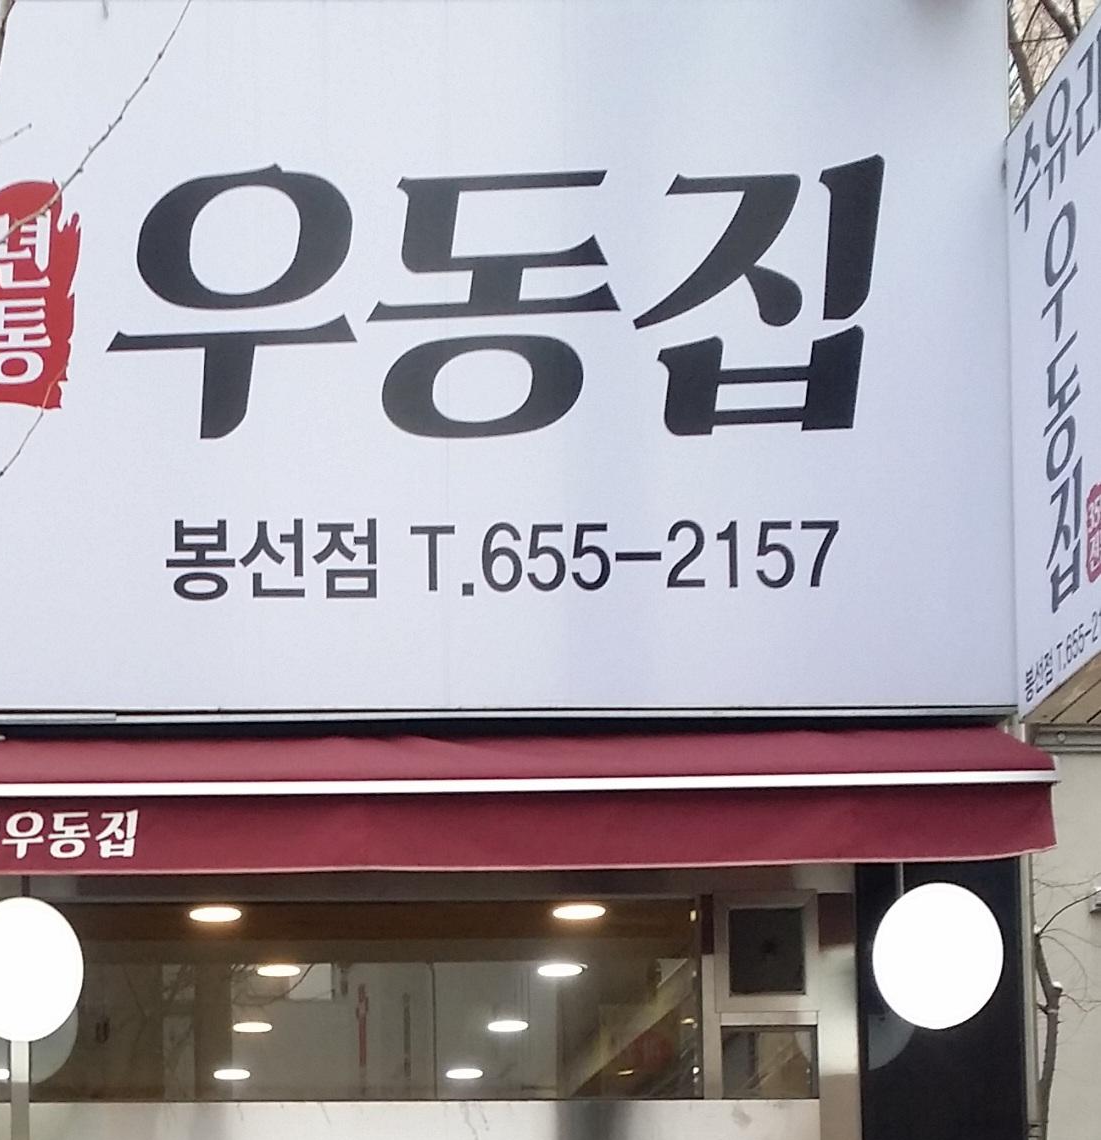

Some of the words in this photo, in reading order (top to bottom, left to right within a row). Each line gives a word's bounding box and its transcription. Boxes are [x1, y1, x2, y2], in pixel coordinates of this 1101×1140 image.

[106, 153, 885, 437] 우동집
[1041, 200, 1083, 614] 우동집
[165, 518, 378, 600] 봉선점
[410, 520, 839, 597] T.655-2157
[1, 809, 139, 859] 우동집
